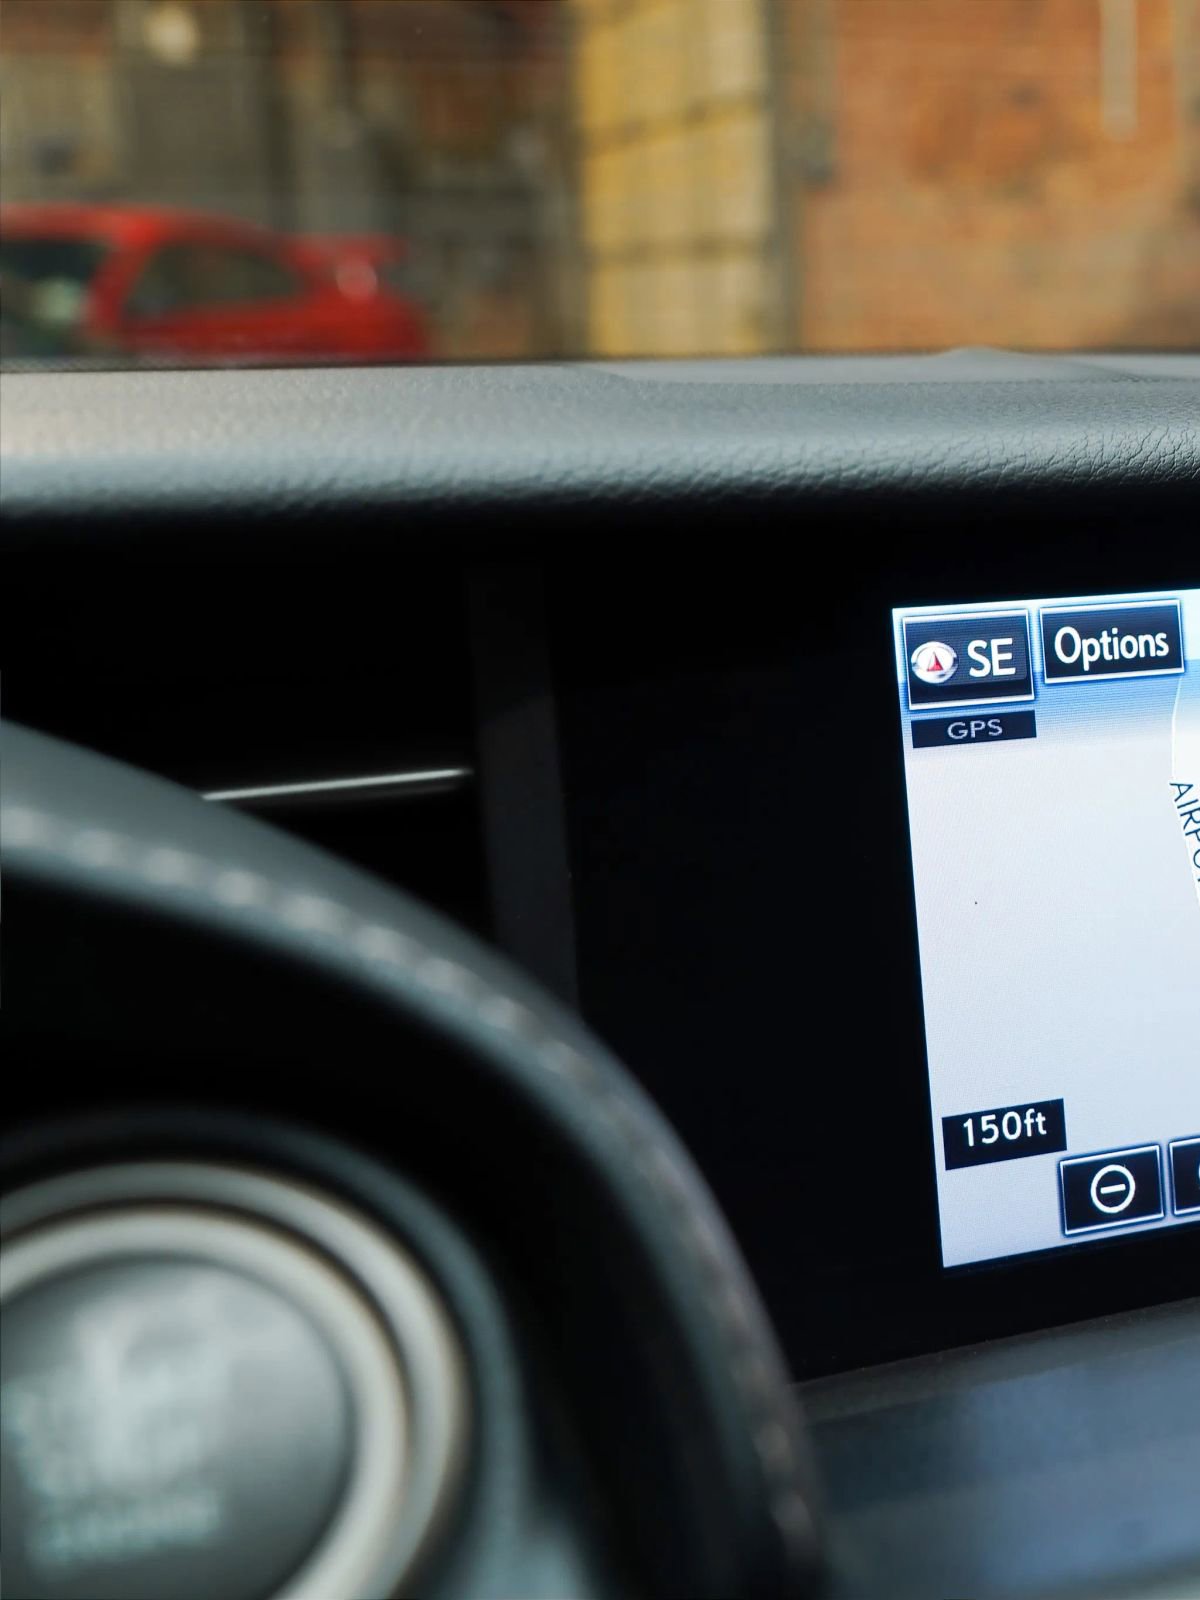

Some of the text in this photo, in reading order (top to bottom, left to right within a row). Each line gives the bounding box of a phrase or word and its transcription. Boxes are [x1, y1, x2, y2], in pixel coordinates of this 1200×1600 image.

[967, 637, 1016, 678] SE
[1054, 625, 1169, 671] Options
[946, 718, 1003, 740] GPS
[962, 1110, 1048, 1147] 150ft
